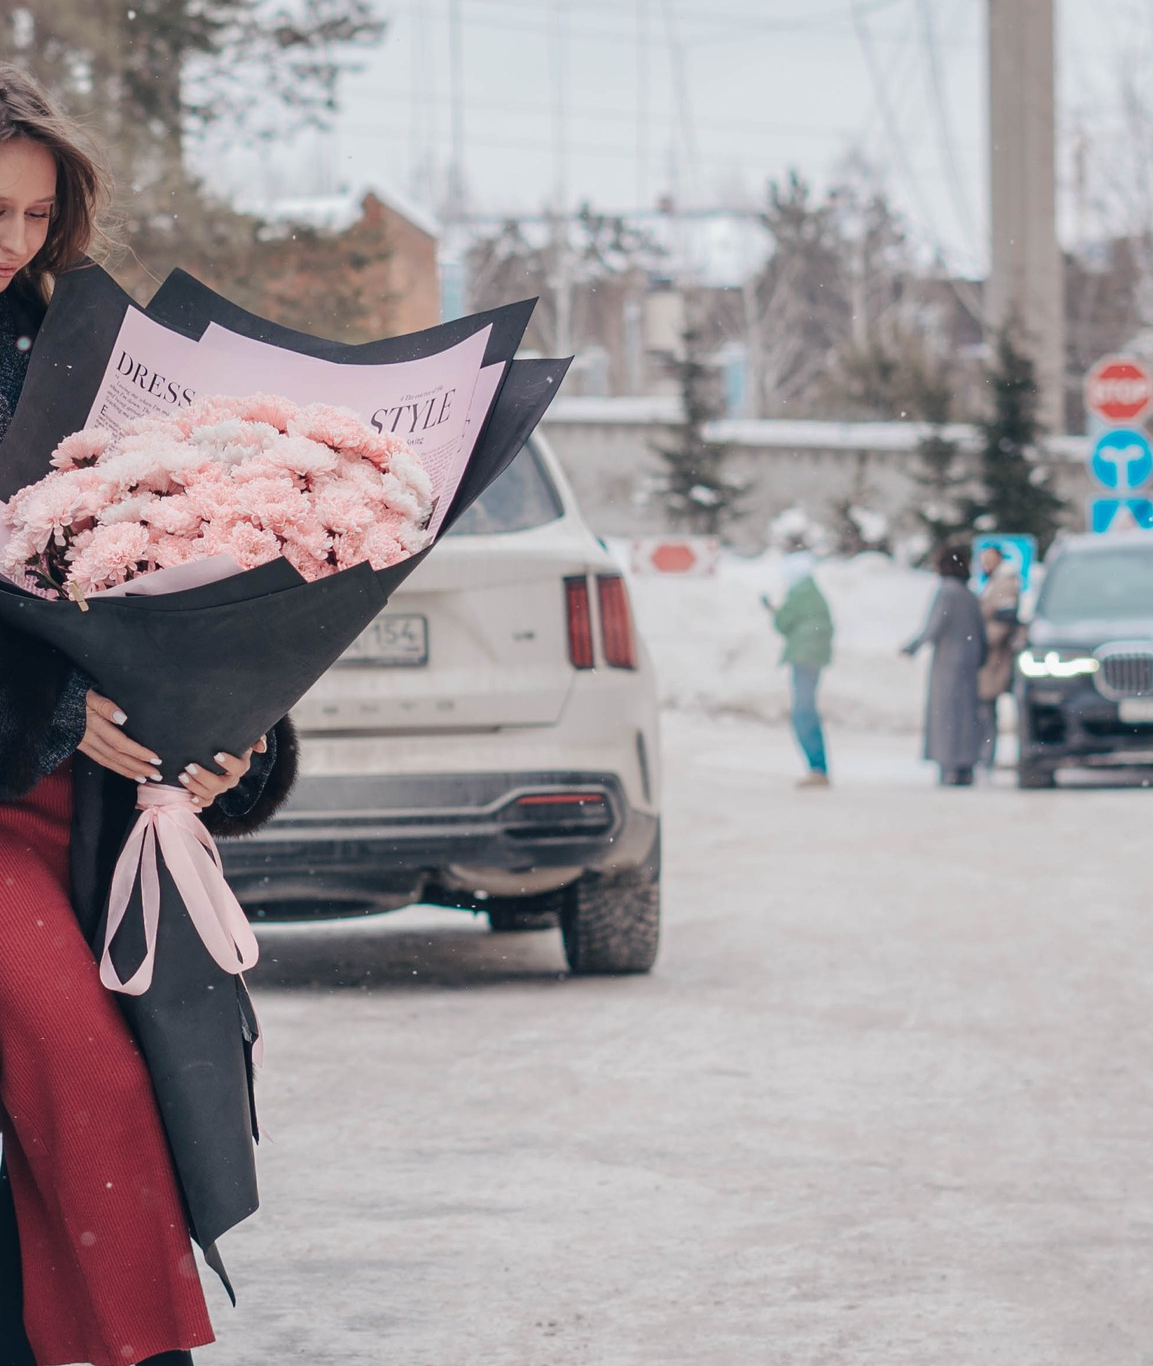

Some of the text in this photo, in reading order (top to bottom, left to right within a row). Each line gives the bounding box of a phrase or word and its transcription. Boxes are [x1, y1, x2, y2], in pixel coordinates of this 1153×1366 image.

[116, 351, 196, 410] DRESS
[370, 388, 456, 434] STYLE
[373, 619, 417, 645] 154
